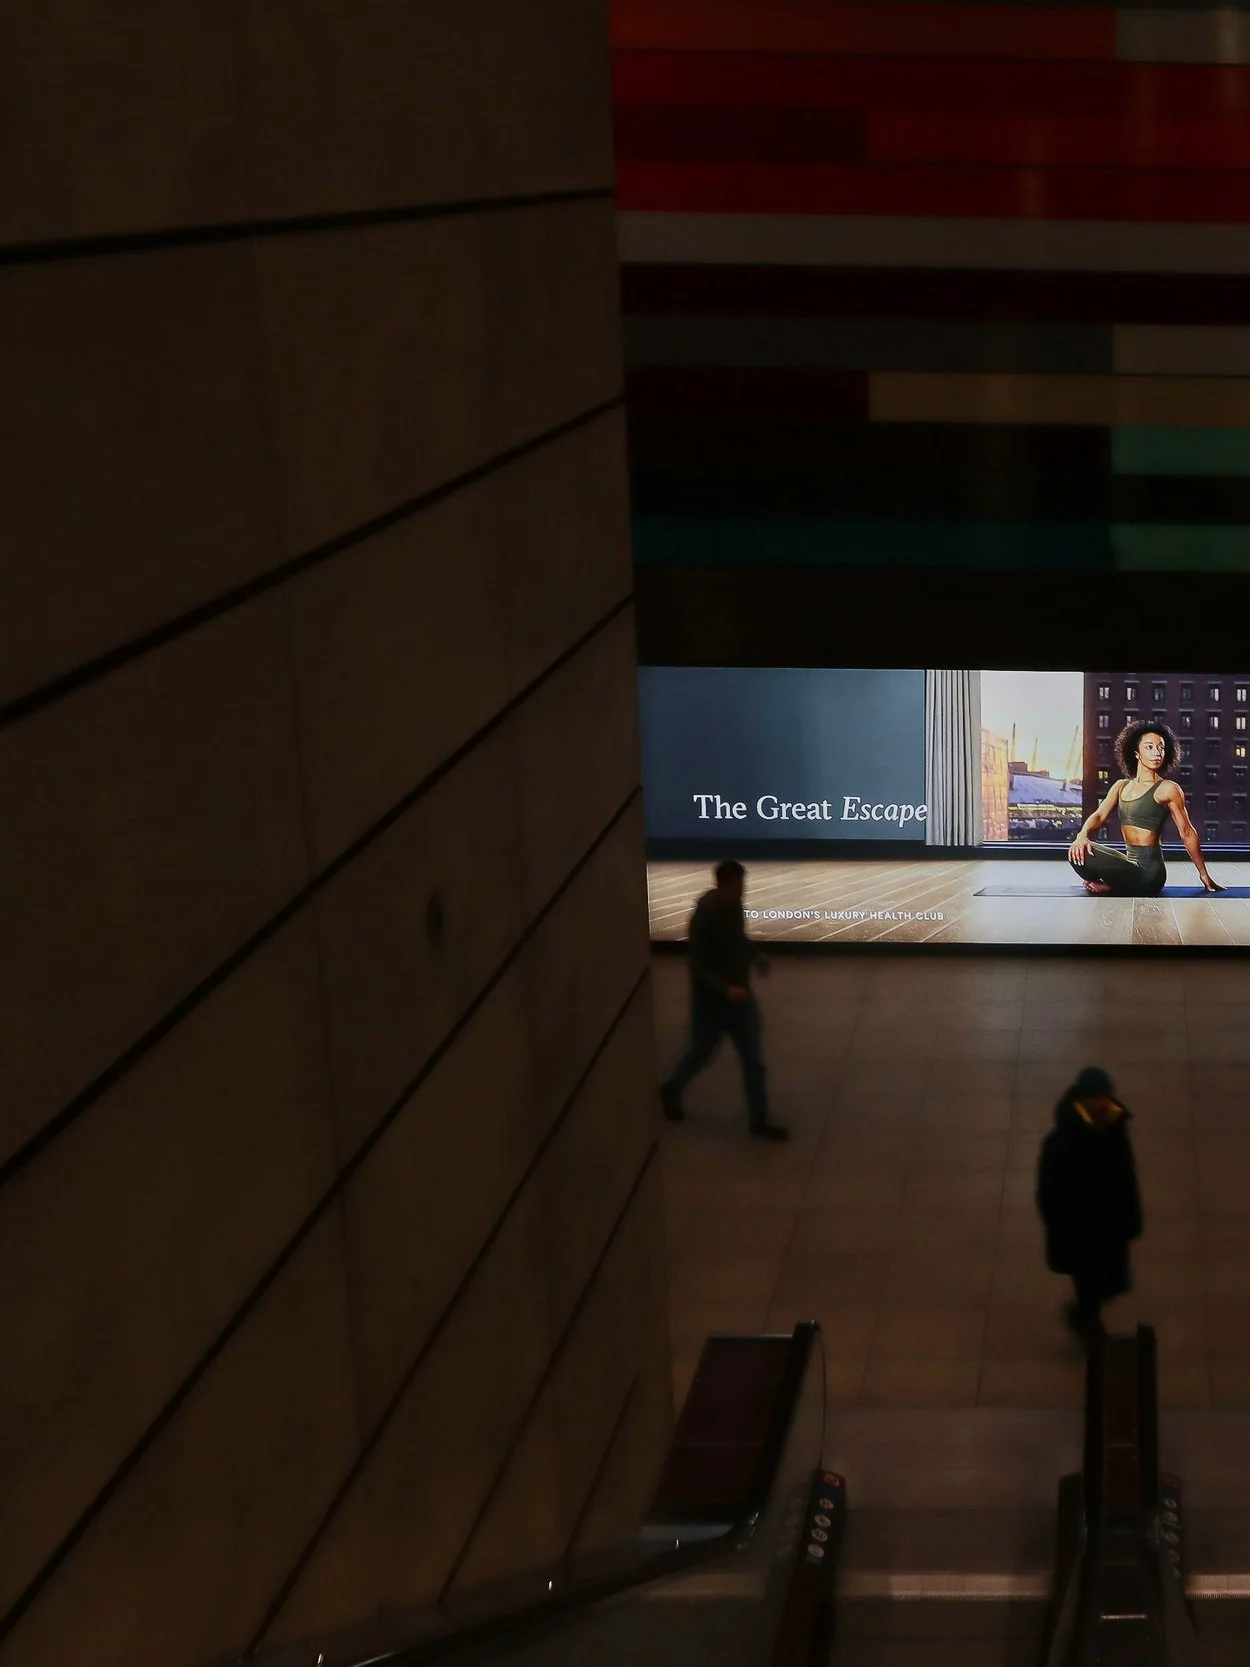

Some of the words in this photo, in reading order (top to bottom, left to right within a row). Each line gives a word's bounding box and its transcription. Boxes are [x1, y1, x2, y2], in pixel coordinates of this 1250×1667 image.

[693, 794, 747, 819] The
[756, 795, 833, 820] Great
[840, 796, 928, 828] Escape
[743, 909, 759, 919] TO
[763, 910, 821, 919] LONDON'S
[824, 911, 866, 920] LUXURY
[870, 911, 912, 920] HEALTH
[915, 912, 944, 920] CLUB
